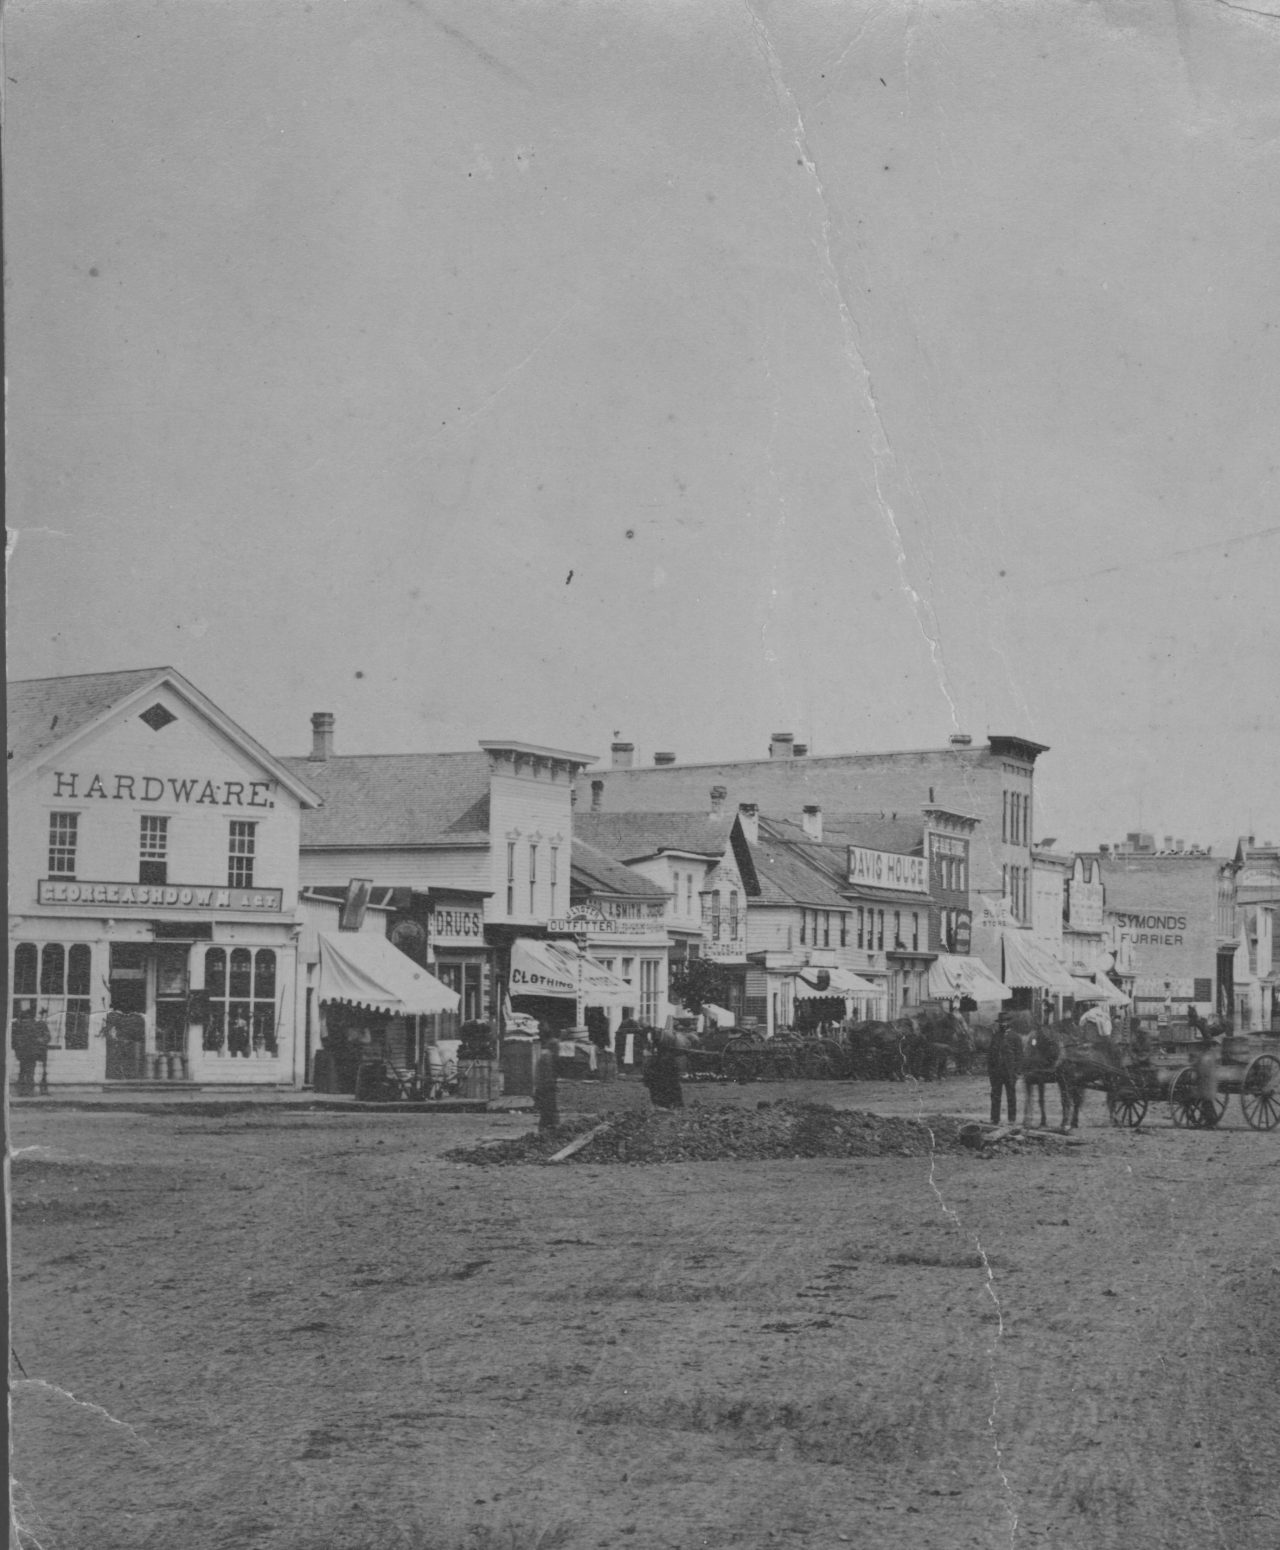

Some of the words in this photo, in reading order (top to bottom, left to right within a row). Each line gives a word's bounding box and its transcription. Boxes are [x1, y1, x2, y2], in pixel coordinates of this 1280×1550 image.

[53, 772, 274, 808] HARDWARE.
[850, 850, 883, 880] DAVIS
[887, 855, 925, 885] HOUSE
[44, 884, 120, 904] GEORGE
[121, 887, 231, 907] ASHDOWN
[437, 911, 480, 936] DRUGS
[550, 921, 613, 931] OUTFITTER
[1118, 915, 1187, 930] SYMONDS
[1120, 933, 1184, 946] FURRIER
[512, 968, 574, 989] CLOTHING
